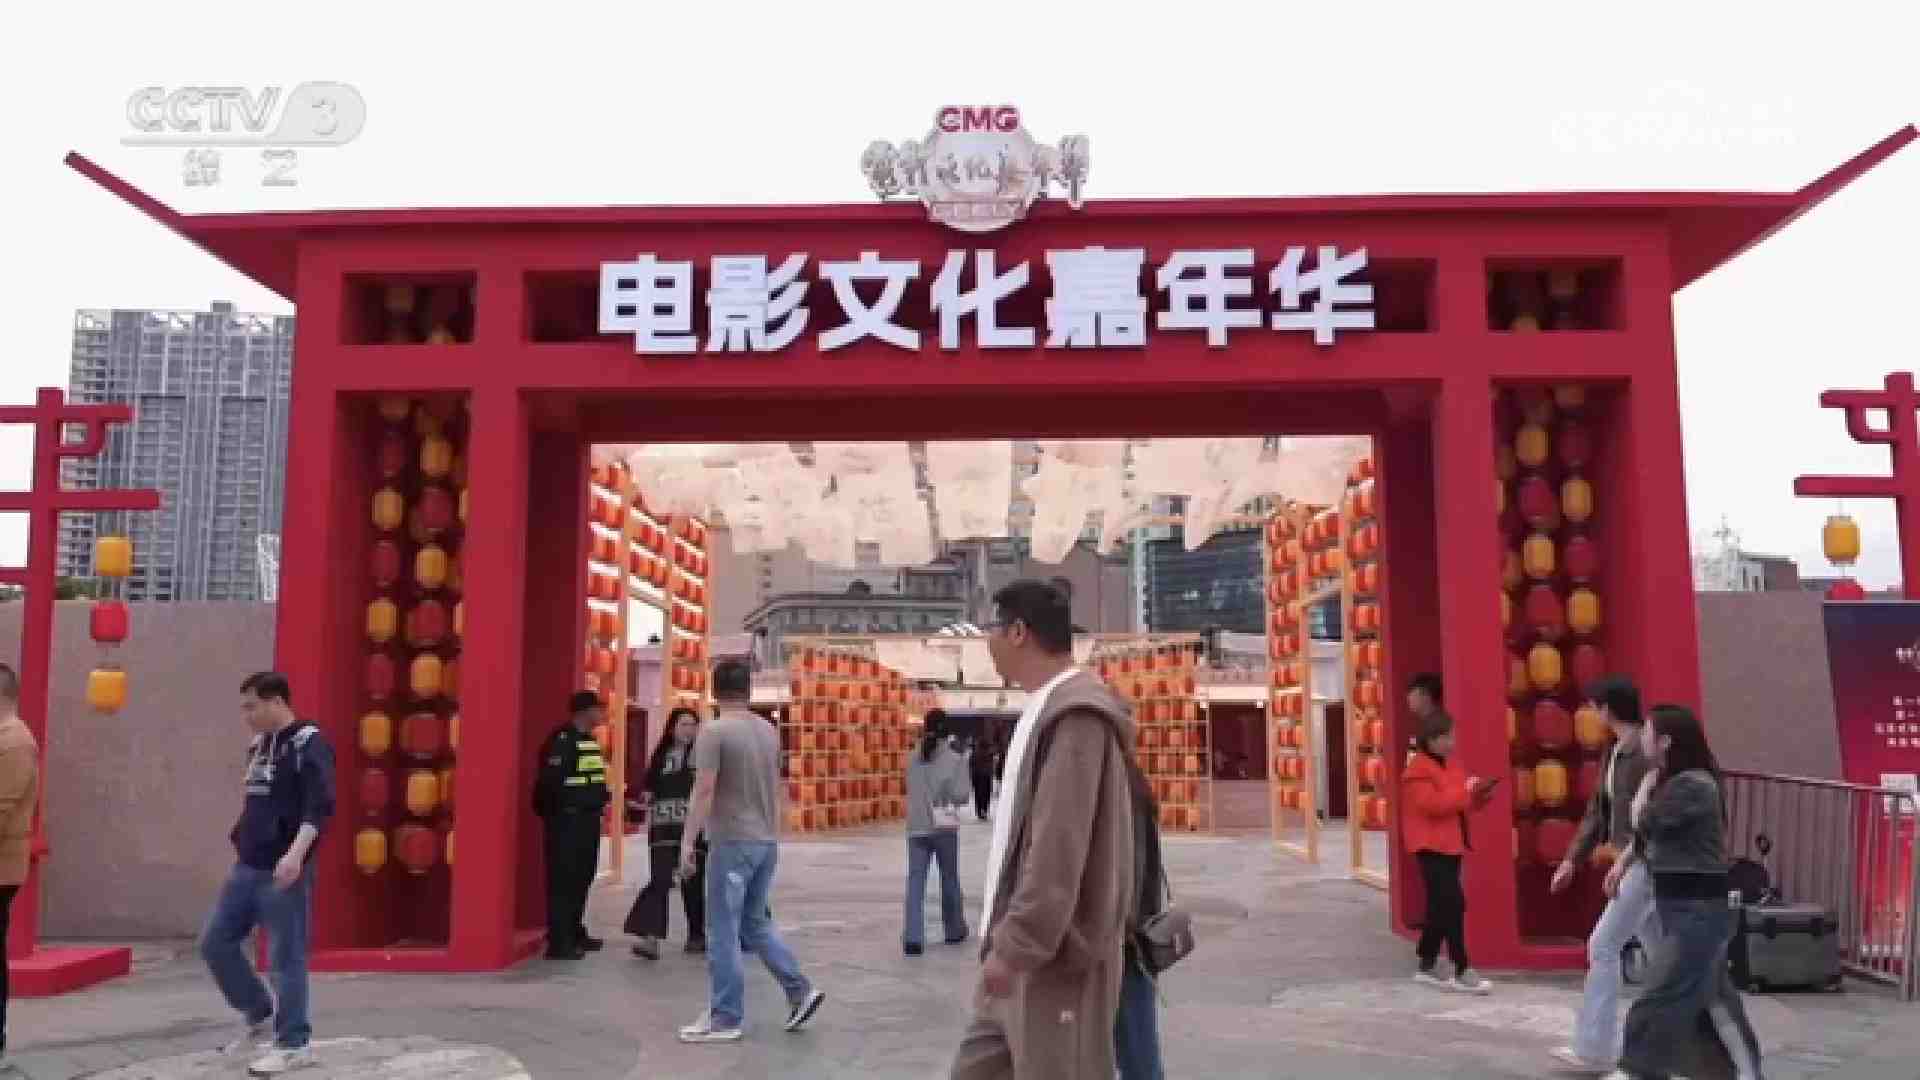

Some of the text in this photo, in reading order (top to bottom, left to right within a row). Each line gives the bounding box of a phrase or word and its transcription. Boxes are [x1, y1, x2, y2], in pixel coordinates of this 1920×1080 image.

[936, 106, 1019, 132] CMG
[599, 246, 1377, 354] 电影文化嘉年华
